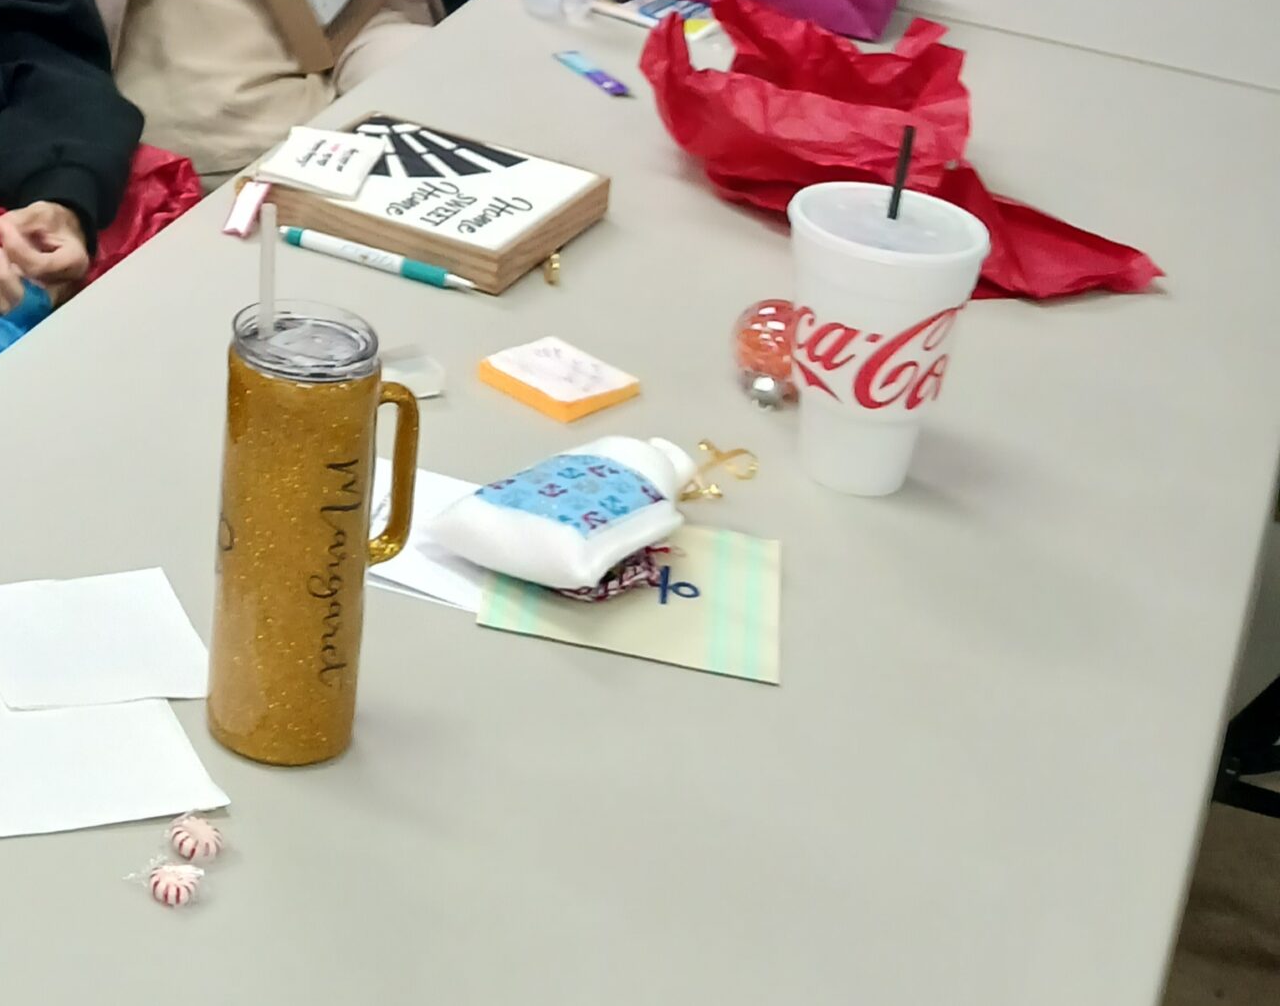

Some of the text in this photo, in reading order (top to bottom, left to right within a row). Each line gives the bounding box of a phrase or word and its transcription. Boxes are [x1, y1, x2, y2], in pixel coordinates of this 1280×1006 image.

[384, 180, 460, 217] Home
[418, 192, 479, 227] SWEET
[456, 195, 534, 235] Home
[306, 457, 363, 690] Margaret
